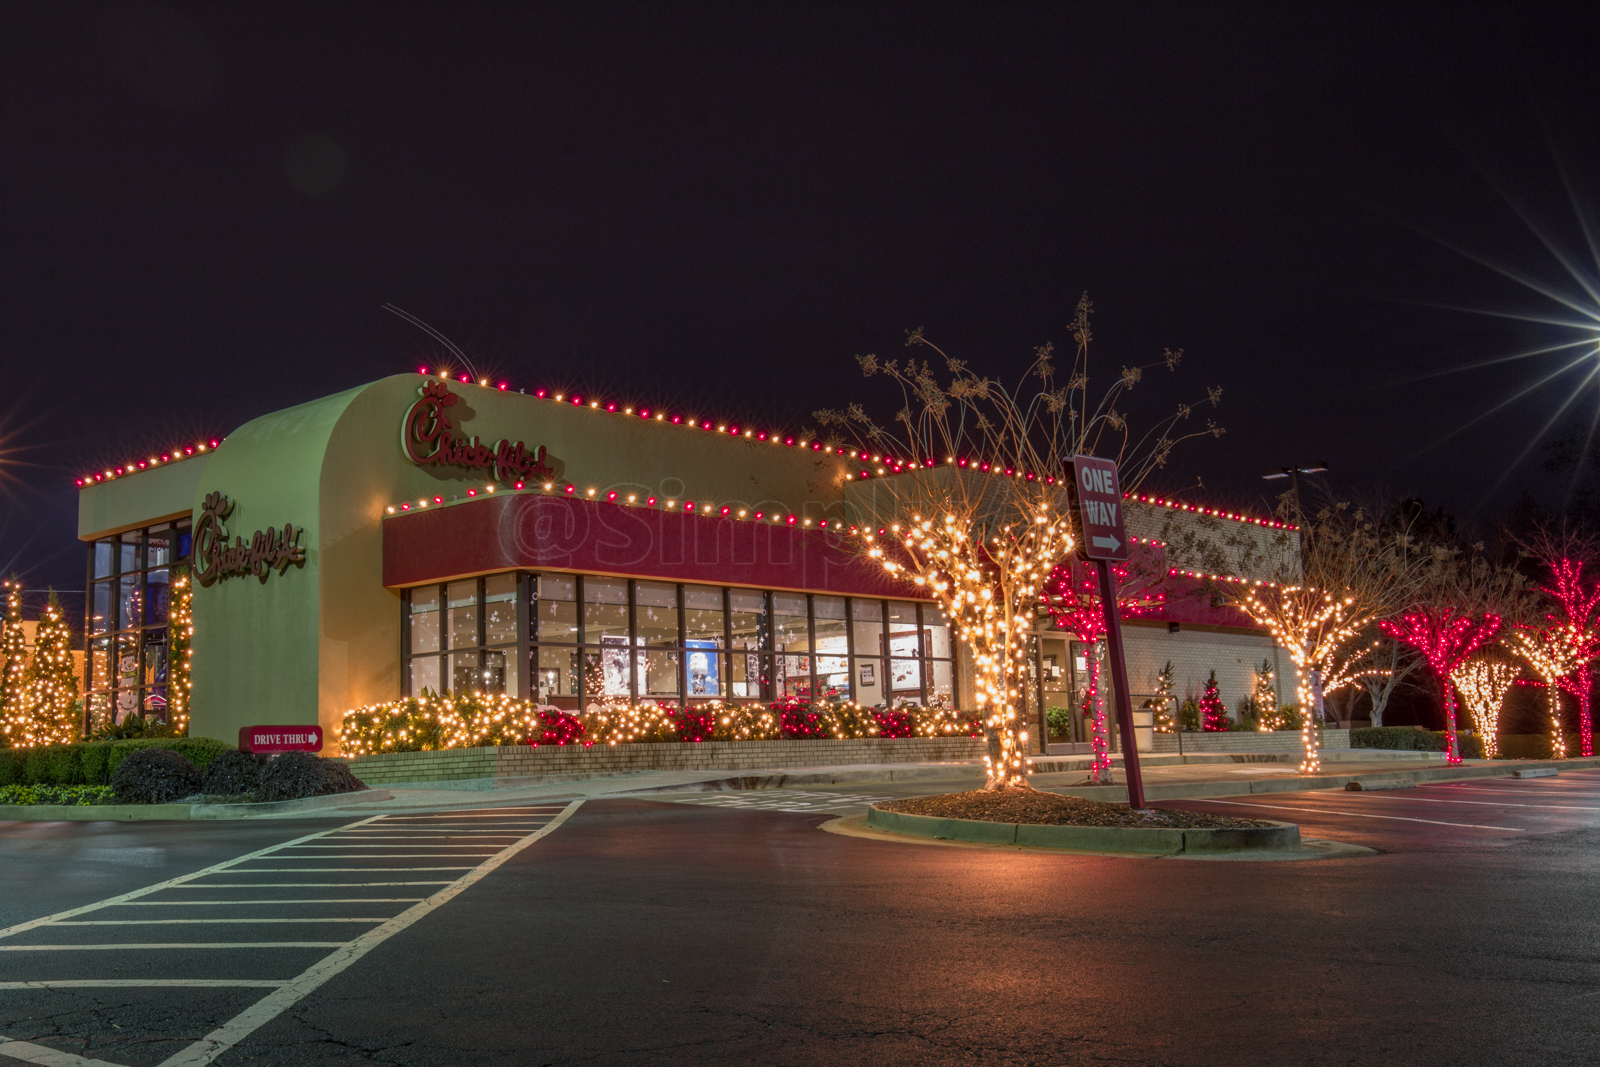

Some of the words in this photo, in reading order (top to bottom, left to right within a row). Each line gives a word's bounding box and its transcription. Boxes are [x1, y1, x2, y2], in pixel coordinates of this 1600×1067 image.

[402, 393, 554, 481] Chick-fil-A
[1082, 466, 1115, 495] ONE
[1084, 499, 1117, 528] WAY
[191, 503, 299, 580] Chick-fil-A
[253, 734, 281, 745] DRIVE
[283, 733, 308, 744] THRU
